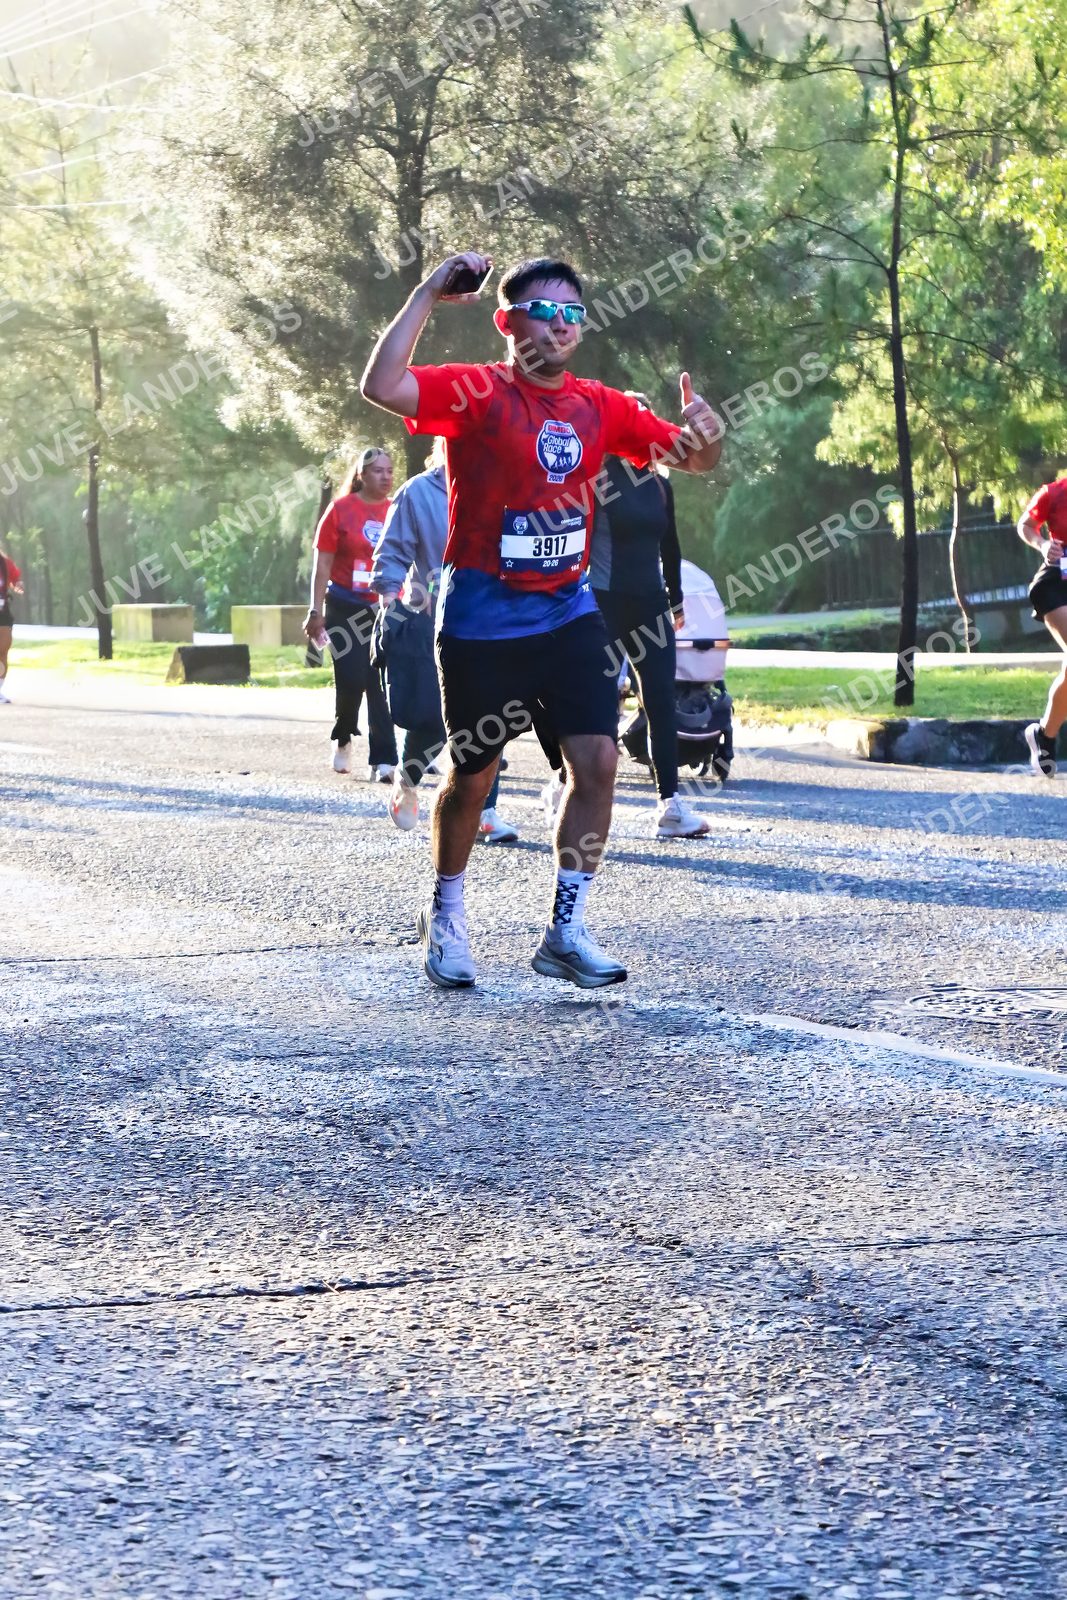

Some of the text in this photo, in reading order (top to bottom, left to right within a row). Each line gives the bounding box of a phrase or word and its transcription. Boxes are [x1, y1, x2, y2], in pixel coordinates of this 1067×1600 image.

[548, 435, 570, 447] Global
[543, 443, 561, 454] Race
[548, 474, 563, 482] 2026
[532, 535, 567, 557] 3917
